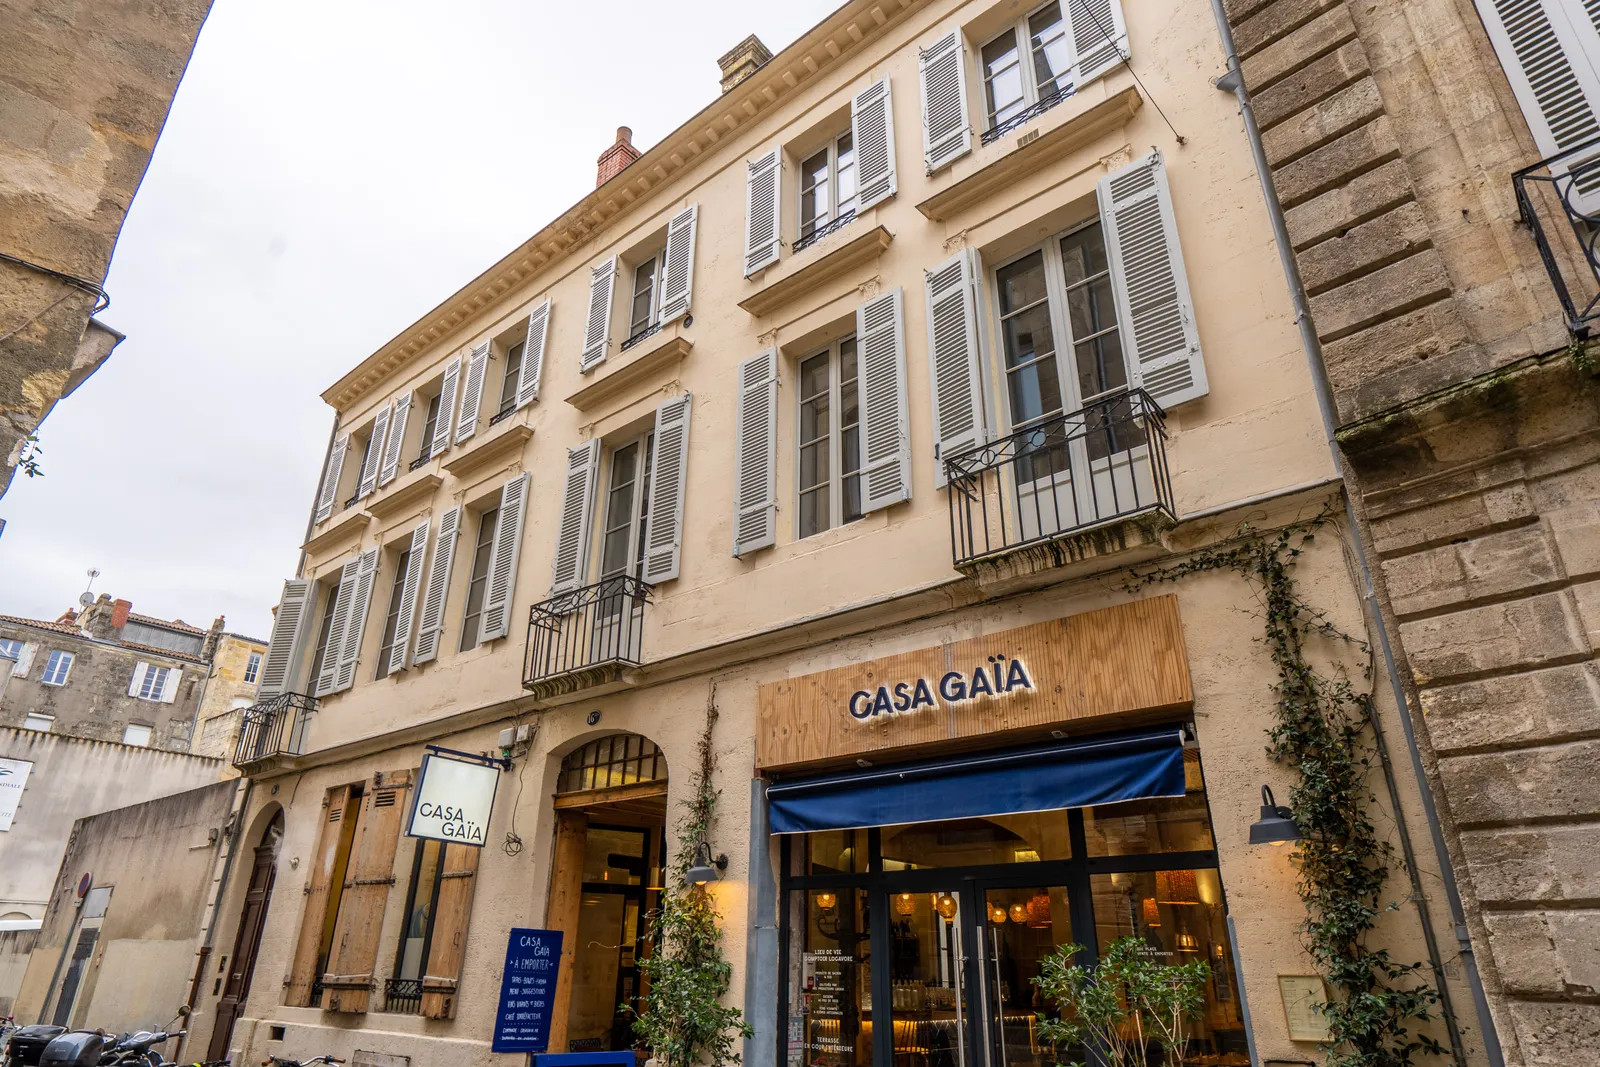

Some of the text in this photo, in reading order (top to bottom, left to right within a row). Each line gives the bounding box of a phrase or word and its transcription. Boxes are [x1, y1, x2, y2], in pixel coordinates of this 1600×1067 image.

[849, 654, 1031, 719] CASA GAÏA
[420, 802, 464, 823] CASA
[442, 821, 482, 841] GAÏA
[520, 936, 541, 947] CASA
[521, 958, 549, 970] EMPORTER
